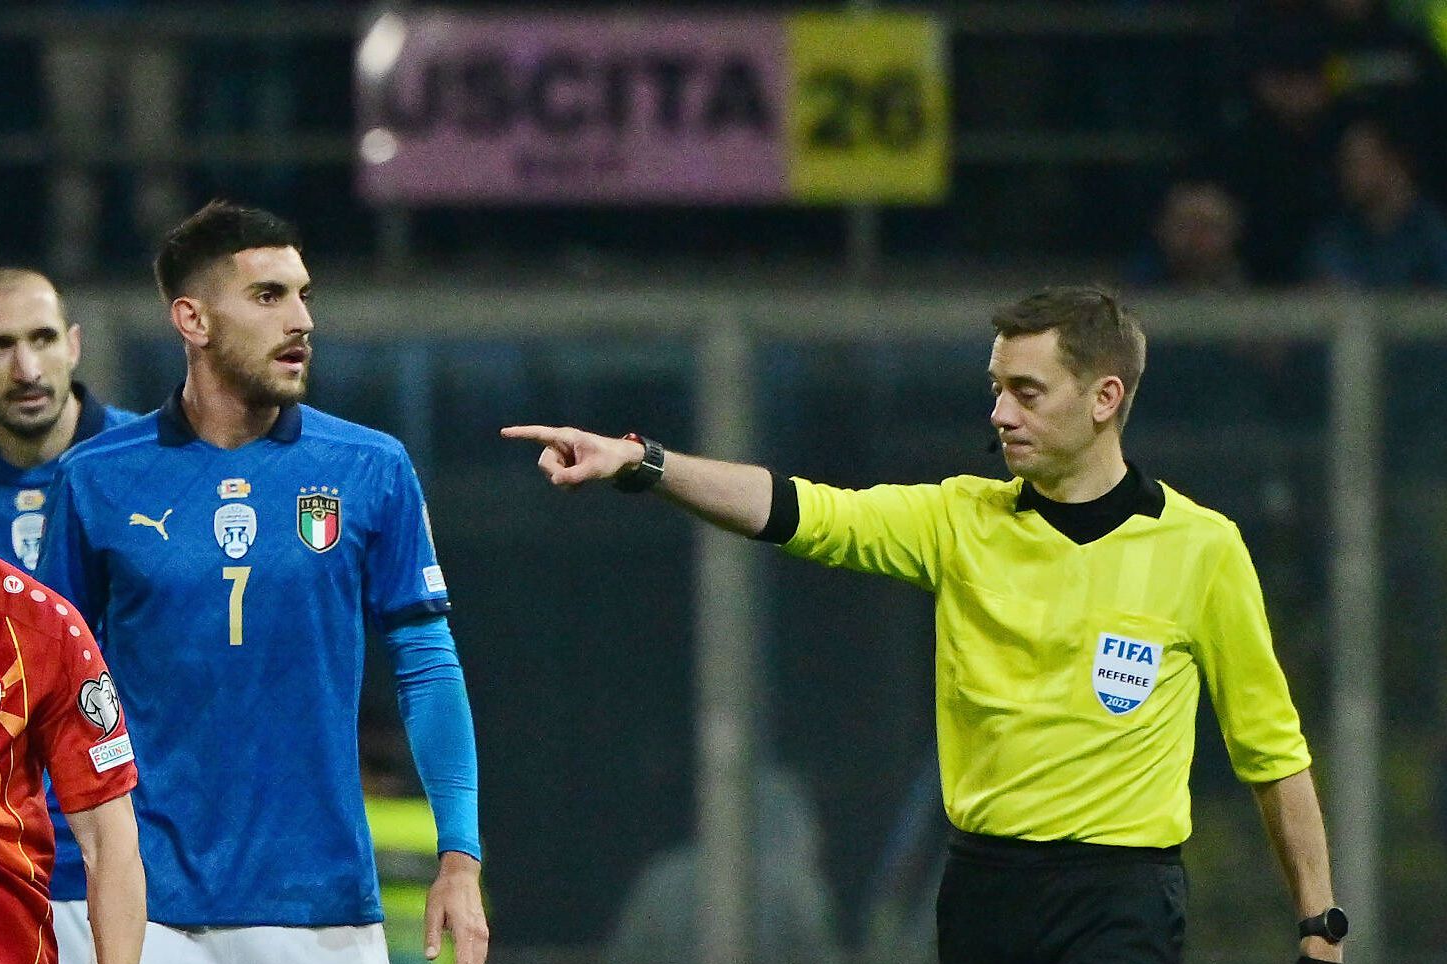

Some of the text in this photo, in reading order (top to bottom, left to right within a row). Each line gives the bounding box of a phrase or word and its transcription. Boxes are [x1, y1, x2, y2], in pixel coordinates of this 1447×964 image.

[382, 48, 925, 151] USCITA 26
[301, 499, 338, 510] ITALIA
[222, 566, 251, 646] 7
[1103, 637, 1153, 665] FIFA
[1098, 668, 1150, 688] REFEREE
[1106, 696, 1131, 709] 2022
